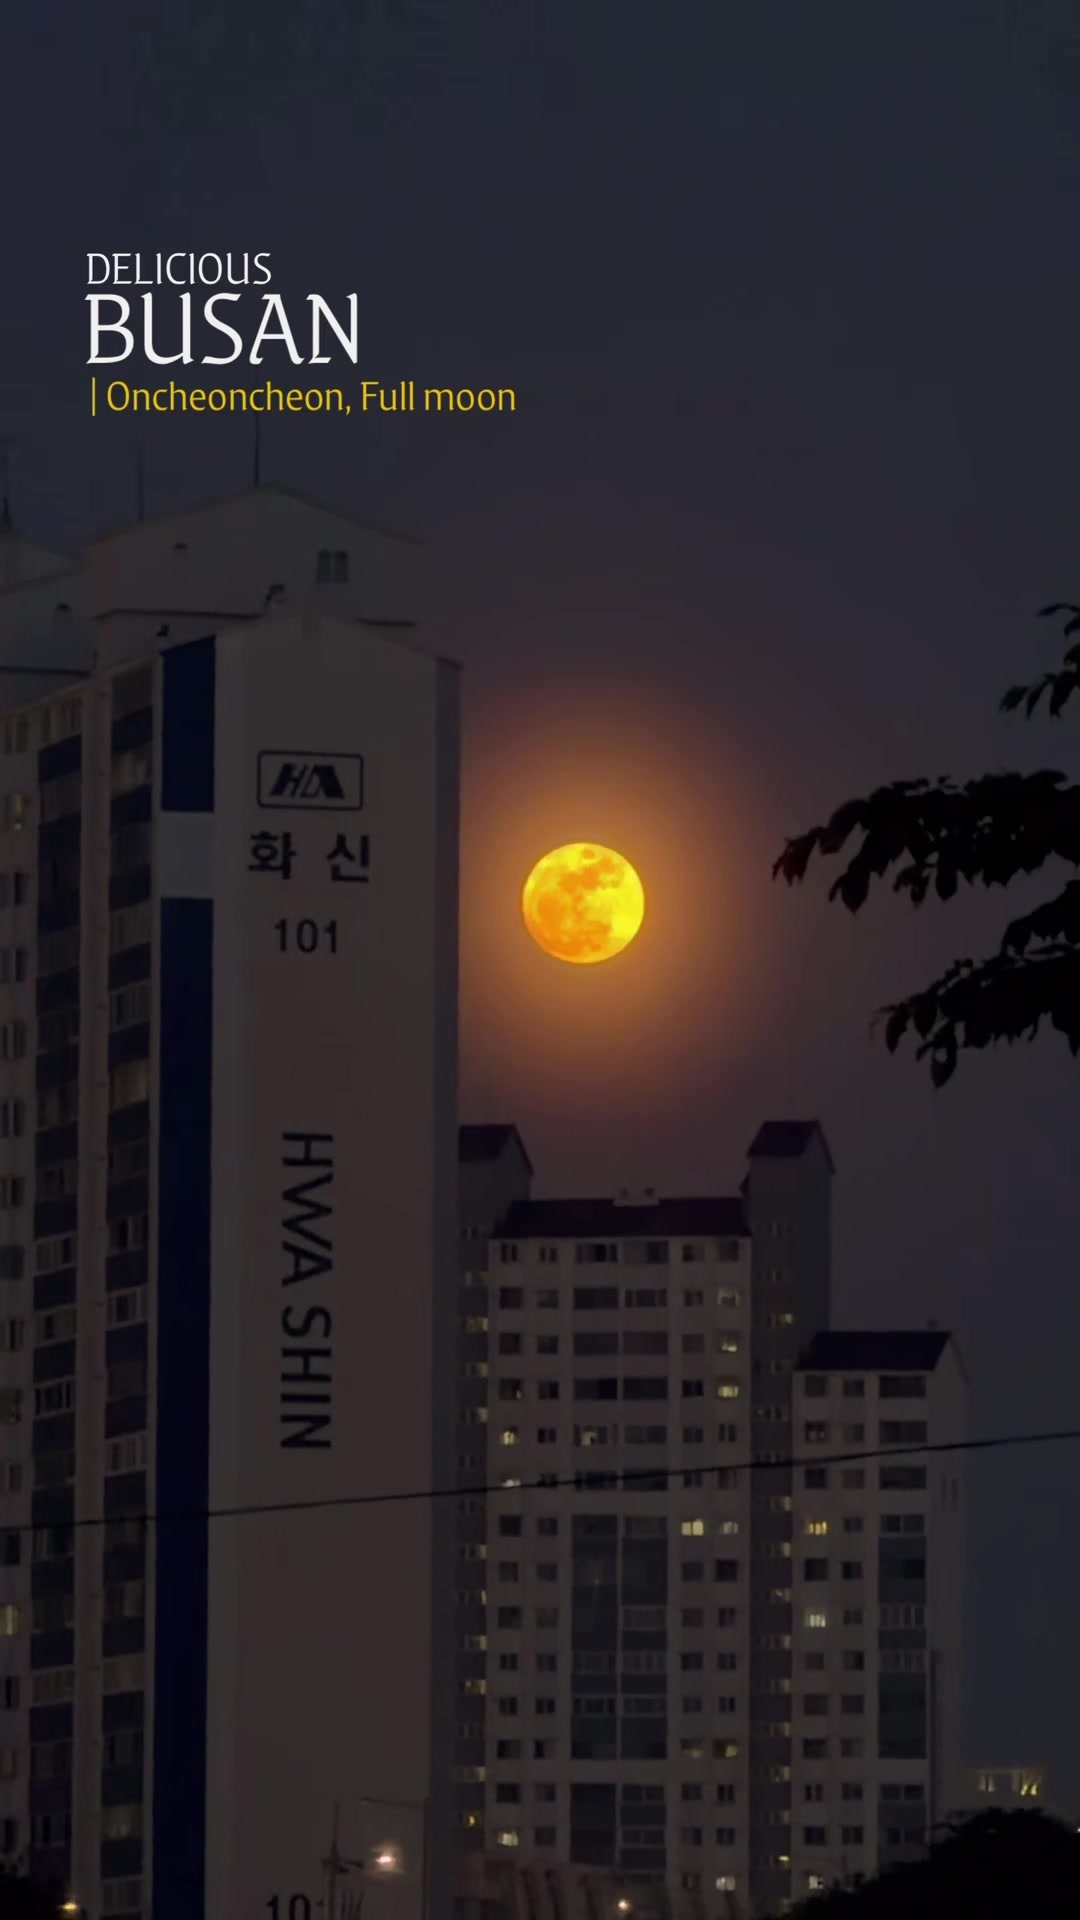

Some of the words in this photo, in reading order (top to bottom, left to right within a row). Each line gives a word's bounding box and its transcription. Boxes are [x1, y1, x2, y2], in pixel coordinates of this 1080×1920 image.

[274, 918, 338, 953] 101
[282, 1132, 333, 1286] HWA
[281, 1305, 332, 1449] SHIN
[266, 1894, 326, 1920] 10
